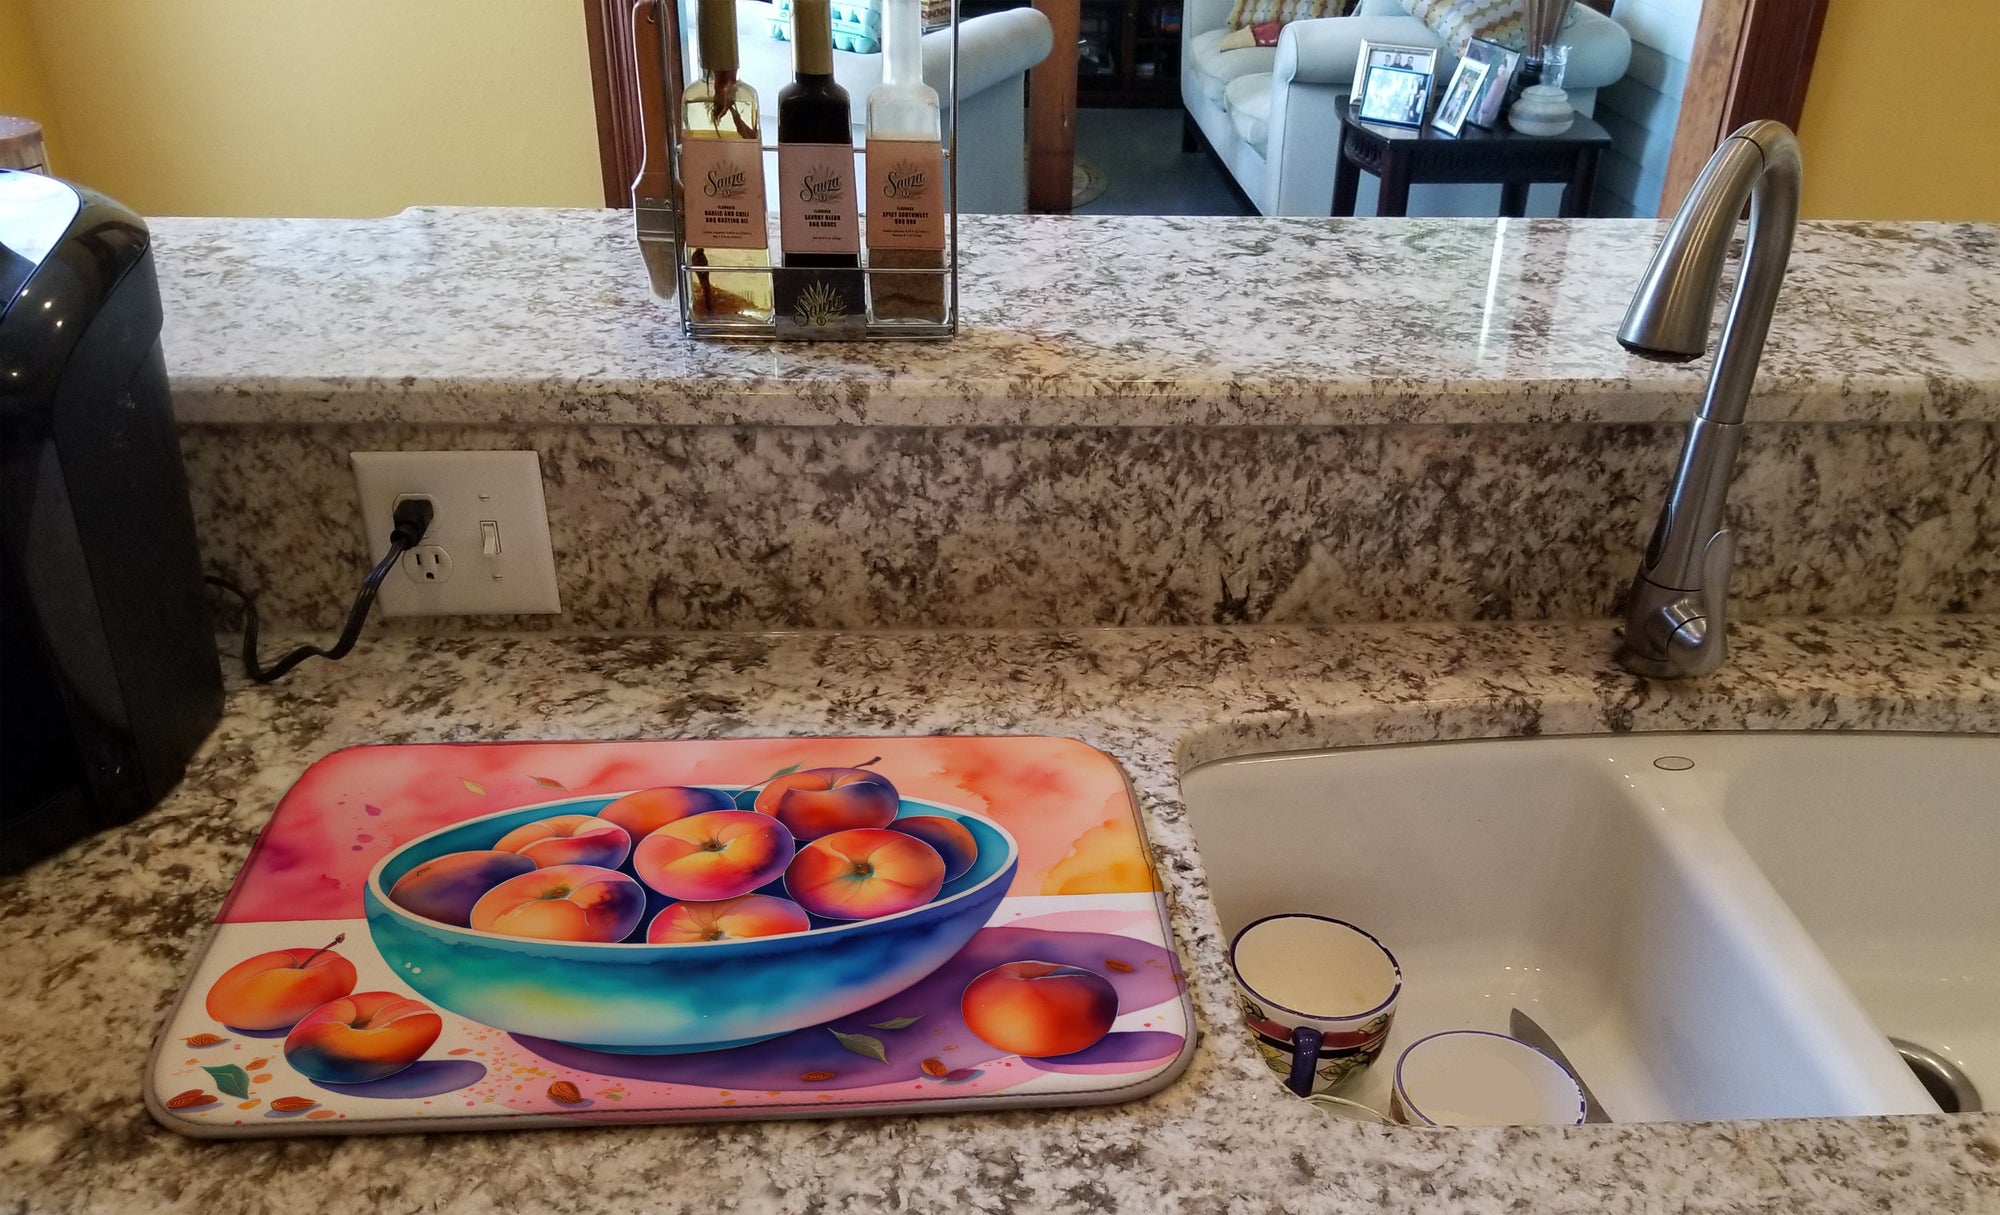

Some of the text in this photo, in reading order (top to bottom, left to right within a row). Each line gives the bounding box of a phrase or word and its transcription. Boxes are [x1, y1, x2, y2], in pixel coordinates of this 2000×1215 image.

[703, 169, 746, 197] Sauza
[800, 175, 842, 201] Sauza
[883, 171, 926, 198] Sauza
